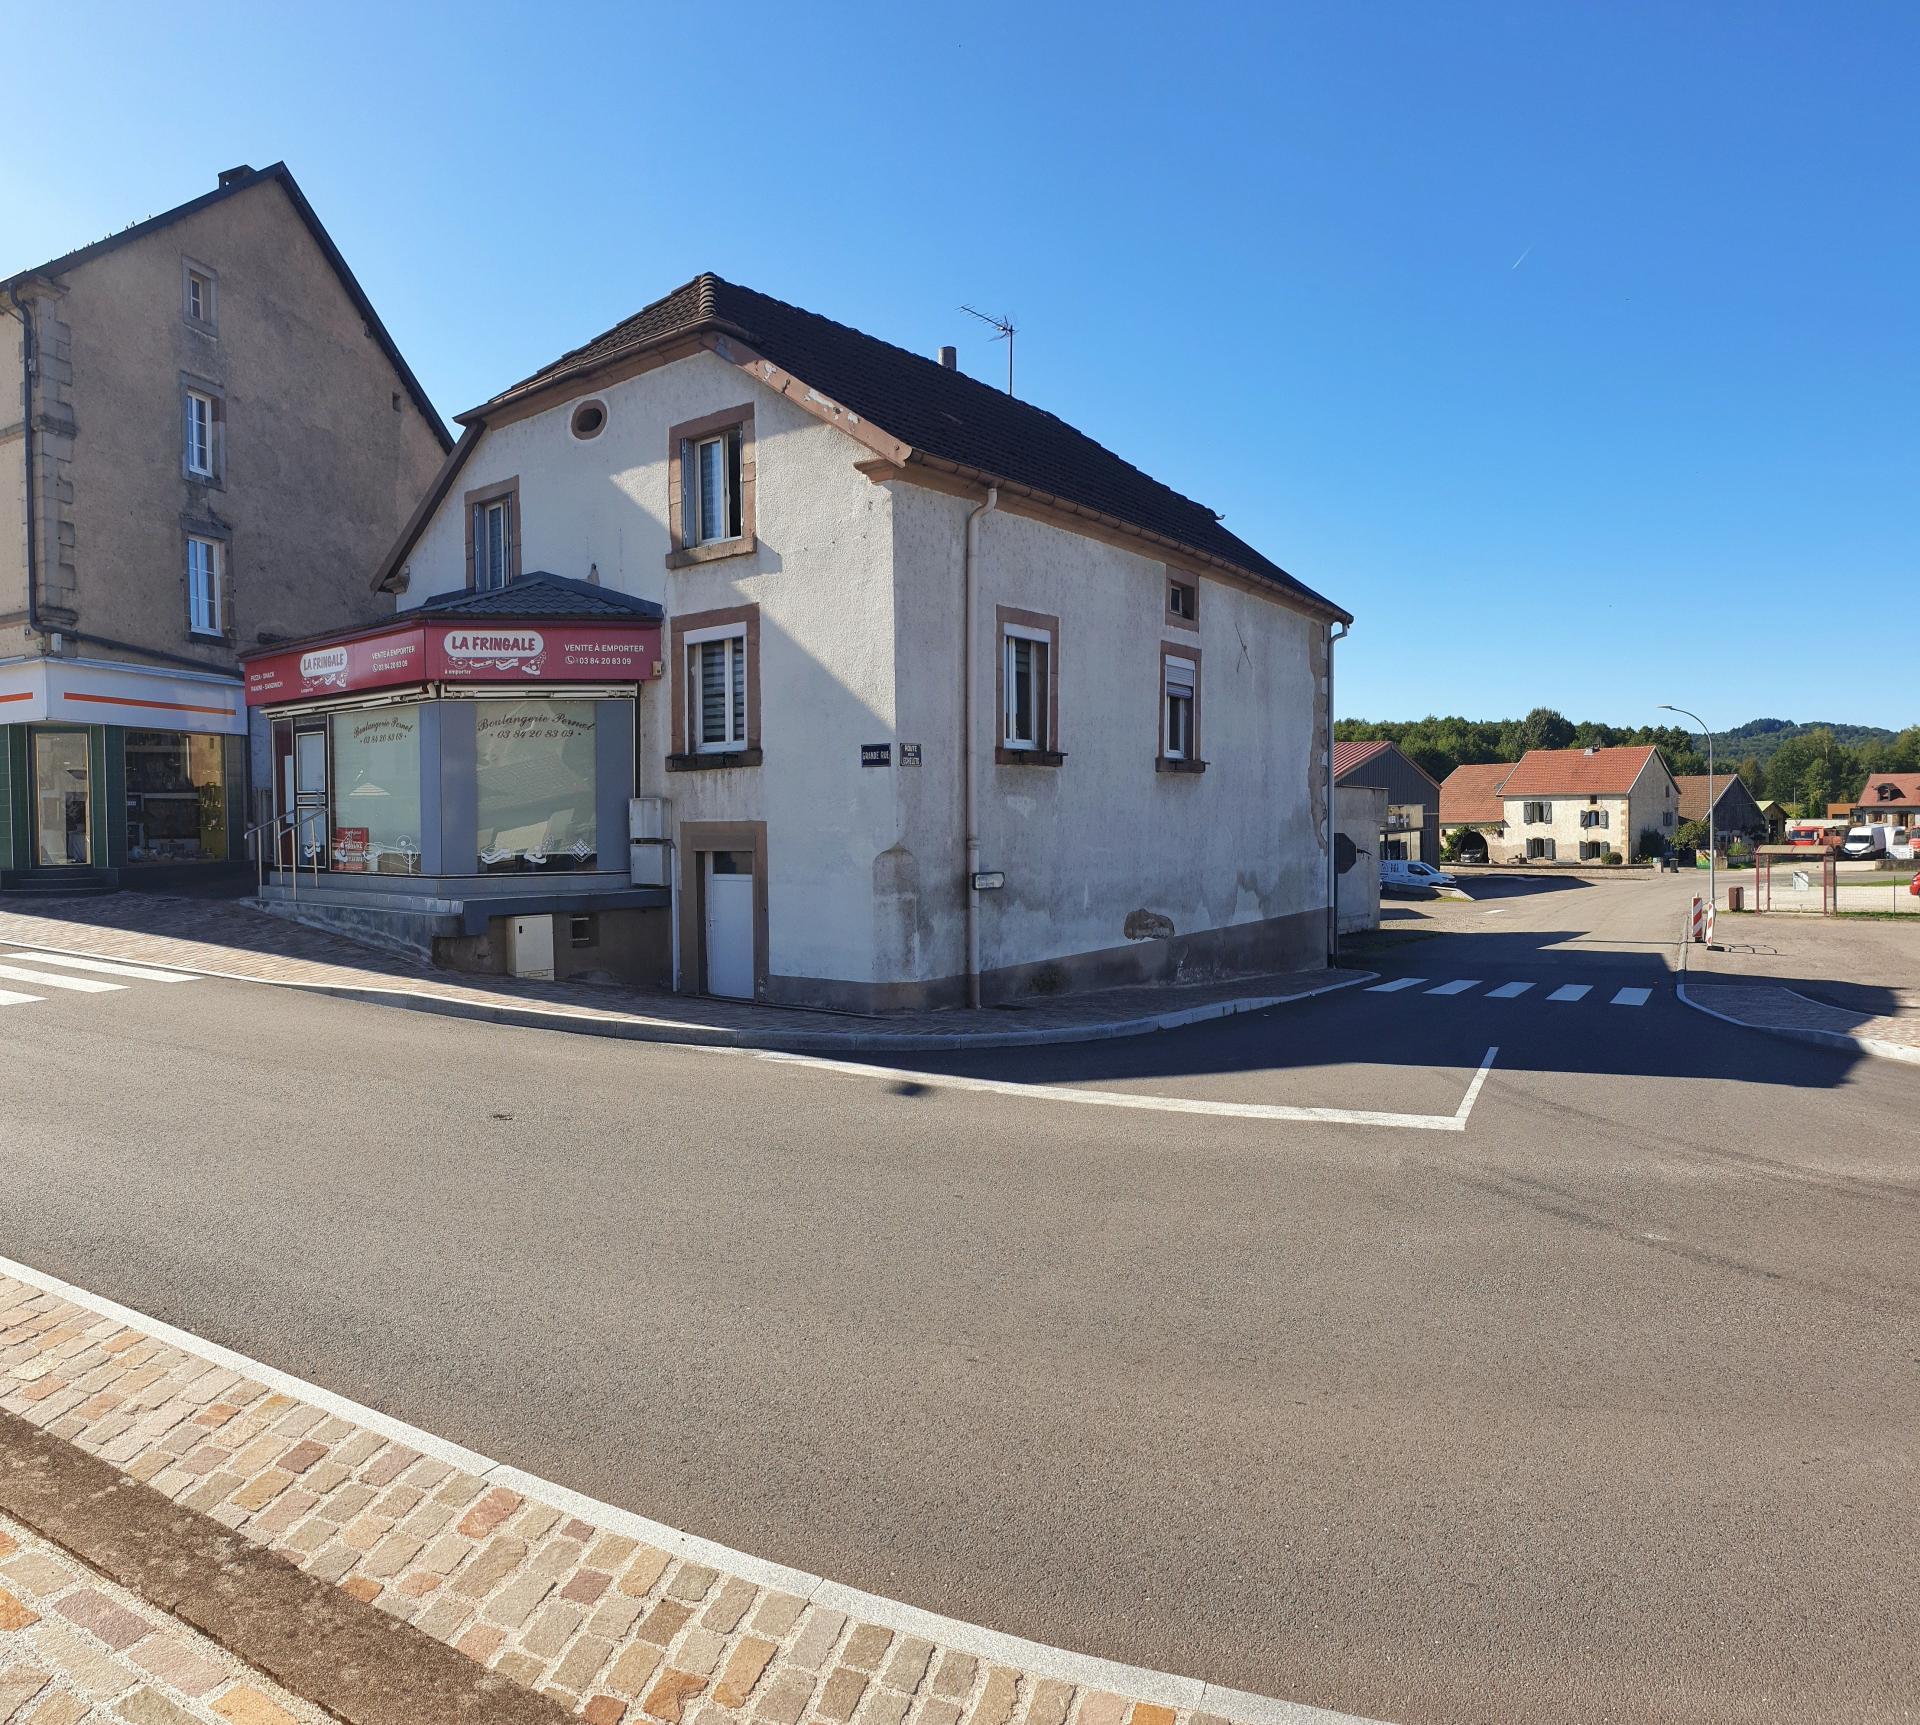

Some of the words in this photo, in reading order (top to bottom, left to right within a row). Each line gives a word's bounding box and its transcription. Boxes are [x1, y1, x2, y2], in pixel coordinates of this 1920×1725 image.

[452, 636, 469, 650] LA
[472, 636, 536, 651] FRINGALE
[564, 644, 593, 652] VENTE
[594, 643, 600, 652] À
[303, 658, 312, 671] LA
[313, 653, 344, 669] FRINGALE
[579, 657, 588, 665] 03
[478, 714, 548, 731] Boulangerie
[863, 751, 879, 760] GRANDE
[880, 750, 889, 759] RUE
